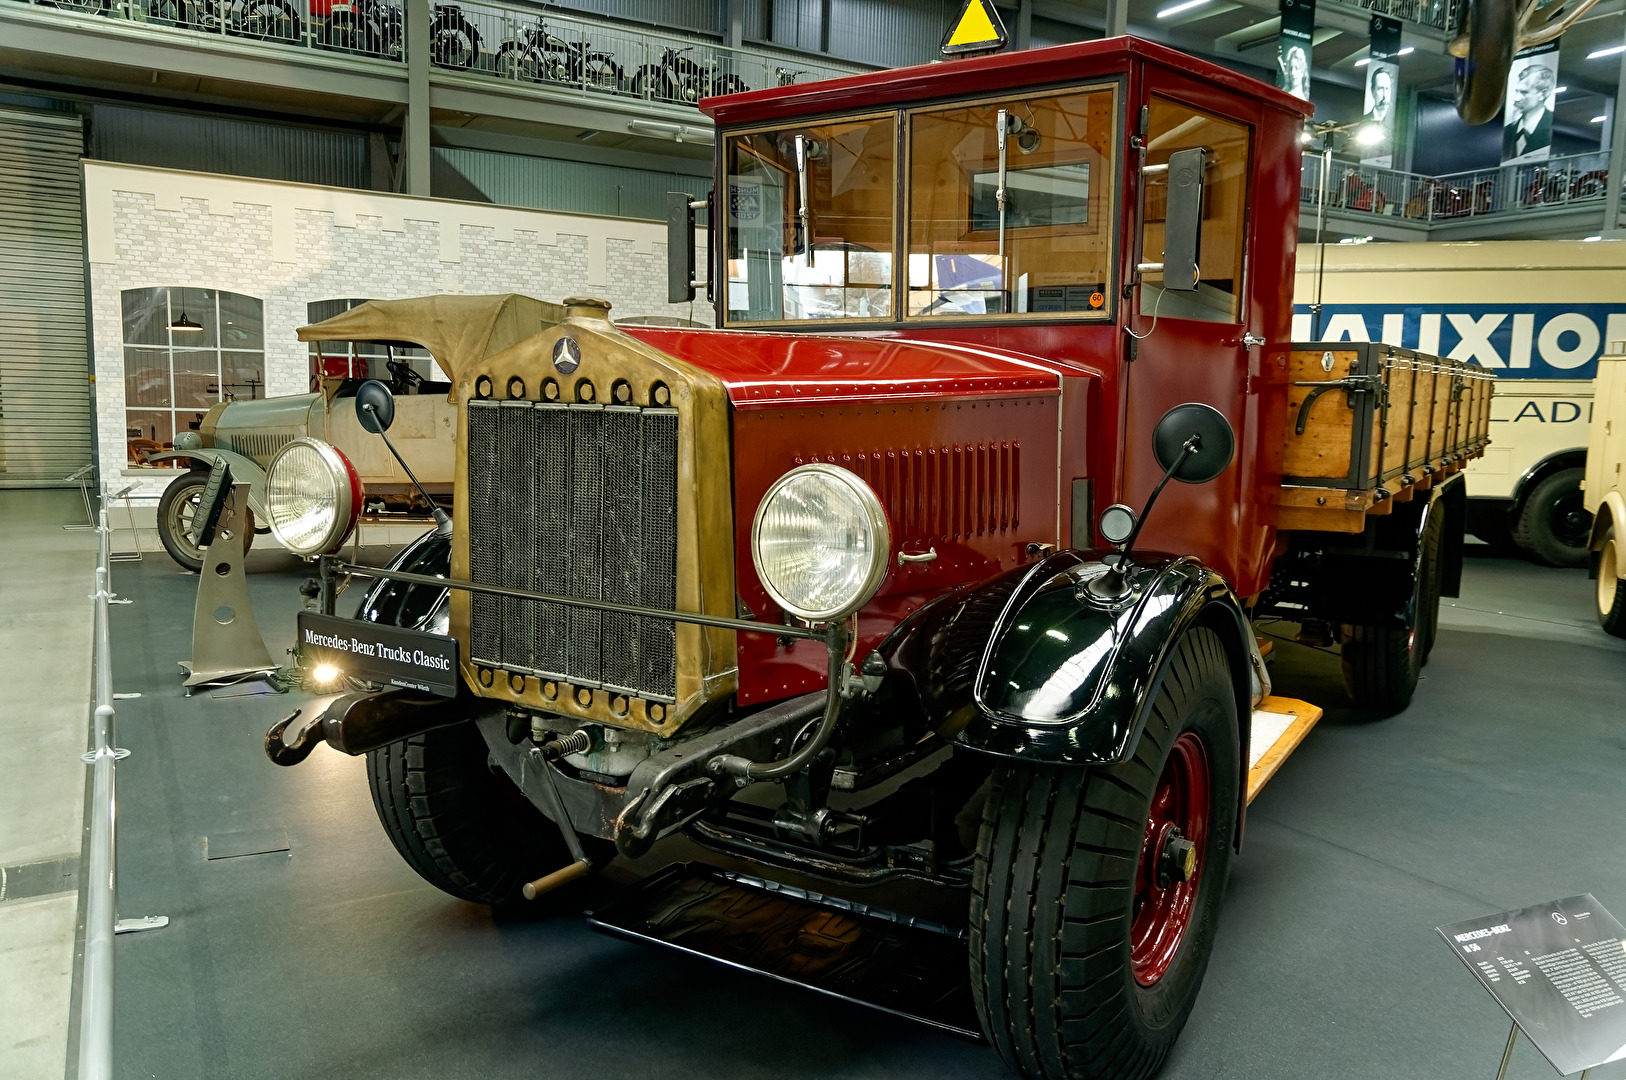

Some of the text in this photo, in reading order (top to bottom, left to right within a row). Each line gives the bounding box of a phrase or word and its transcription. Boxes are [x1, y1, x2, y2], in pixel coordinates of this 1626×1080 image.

[1291, 312, 1626, 369] AUXIO
[305, 630, 450, 671] Mercedes-Benz Trucks Classic
[1454, 924, 1512, 942] MERCEDES-BENZ
[1468, 942, 1481, 953] 56
